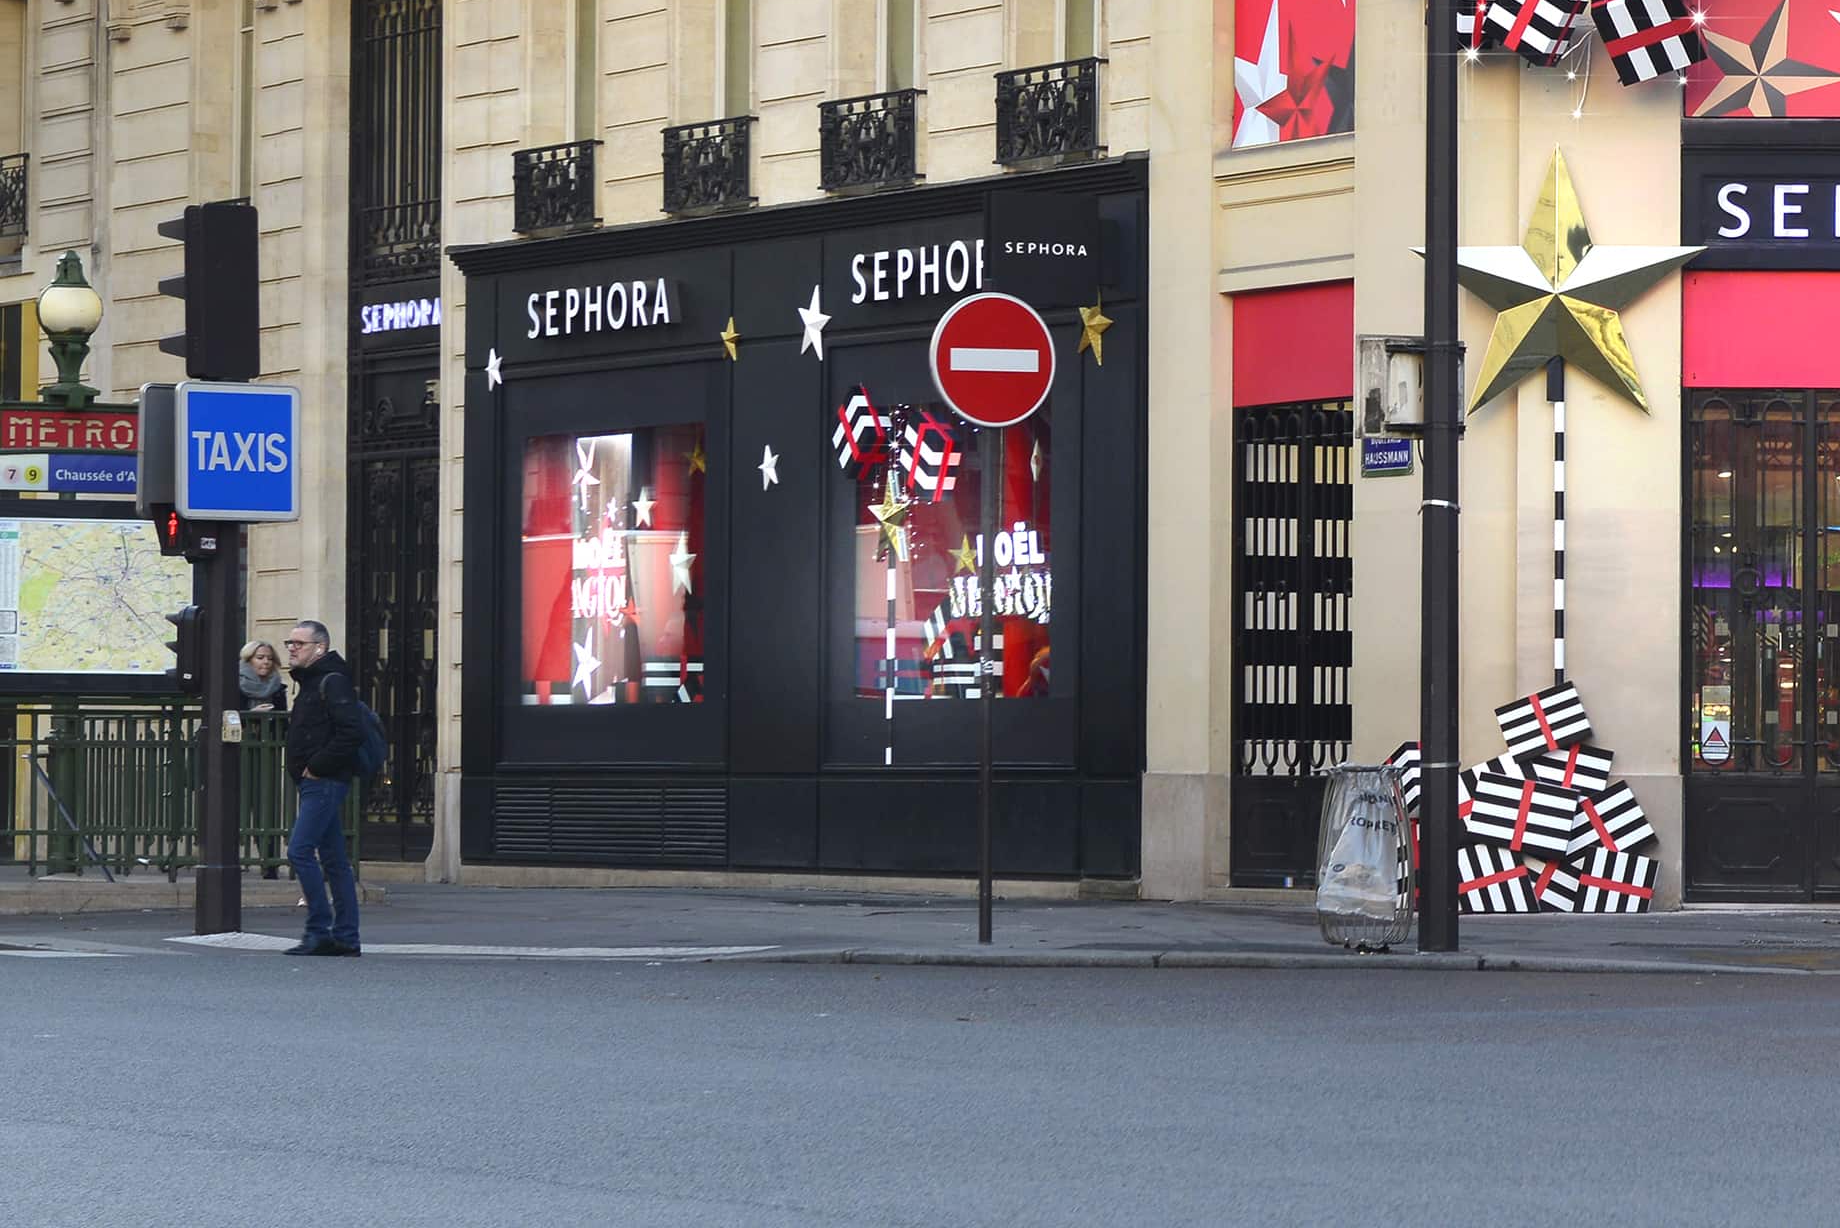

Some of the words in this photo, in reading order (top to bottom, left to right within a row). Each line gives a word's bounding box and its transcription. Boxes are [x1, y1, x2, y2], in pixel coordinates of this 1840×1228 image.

[1004, 241, 1089, 257] SEPHORA
[528, 278, 671, 339] SEPHORA
[192, 431, 288, 472] TAXIS
[1365, 451, 1409, 464] HAUSSMANN
[8, 469, 17, 480] 7
[28, 468, 38, 481] 9
[55, 468, 114, 482] Chaussée
